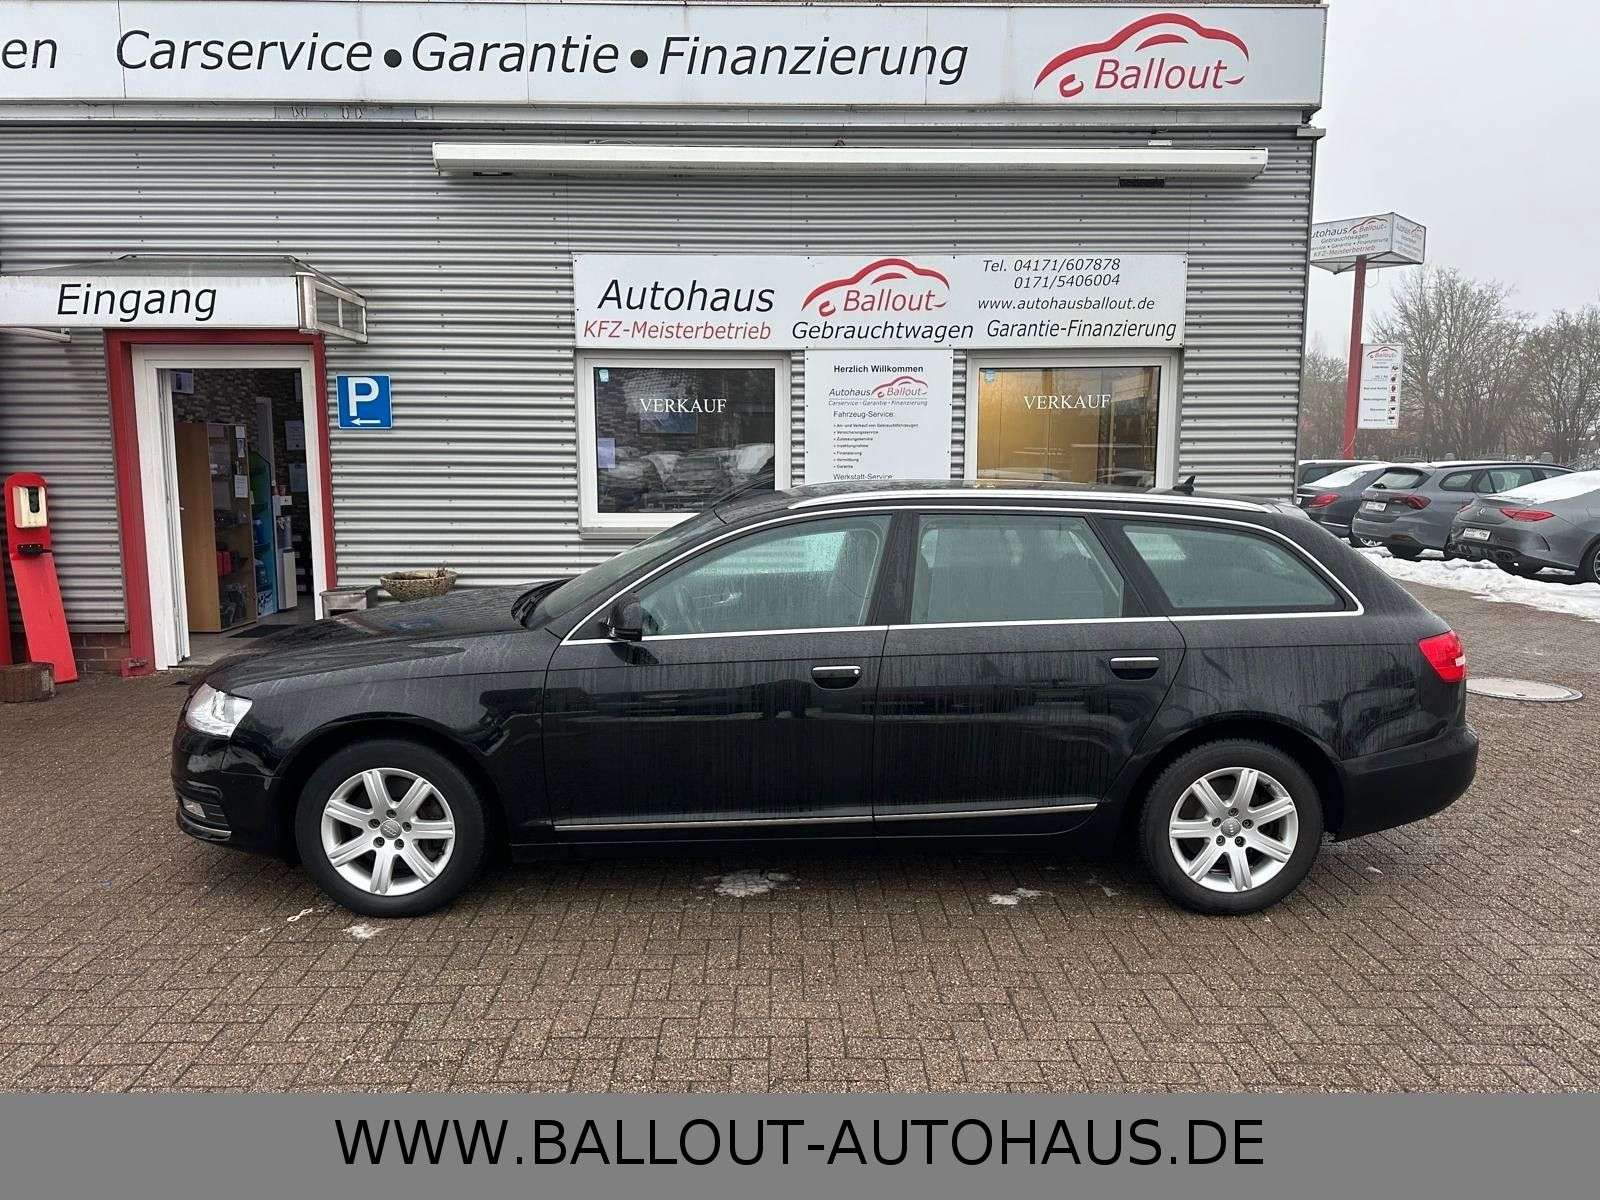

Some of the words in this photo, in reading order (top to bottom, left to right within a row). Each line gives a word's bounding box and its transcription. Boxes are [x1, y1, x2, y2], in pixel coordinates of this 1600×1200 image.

[1, 38, 58, 70] en
[116, 30, 373, 72] Carservice
[412, 31, 619, 74] Garantie
[659, 36, 969, 86] Finanzierung
[1094, 57, 1228, 90] Ballout
[1311, 227, 1348, 238] utohaus
[983, 259, 1008, 273] Tel.
[1013, 257, 1121, 273] 04171/607878
[1013, 274, 1121, 290] 0171/5406004
[57, 282, 218, 323] Eingang
[596, 279, 775, 313] Autohaus
[843, 288, 936, 312] Ballout
[977, 296, 1156, 310] www.autohausballout.de
[583, 320, 772, 341] KFZ-Meisterbetrieb
[791, 320, 974, 344] Gebrauchtwagen
[986, 319, 1177, 342] Garantie-Finanzierung
[833, 365, 869, 373] Herzlich
[870, 365, 924, 373] Willkommen
[348, 377, 379, 416] P
[828, 388, 871, 397] Autohaus
[886, 387, 922, 397] Ballout
[1023, 393, 1111, 410] VERKAUF
[639, 398, 728, 413] VERKAUF
[833, 411, 894, 419] Fahrzeug-Service
